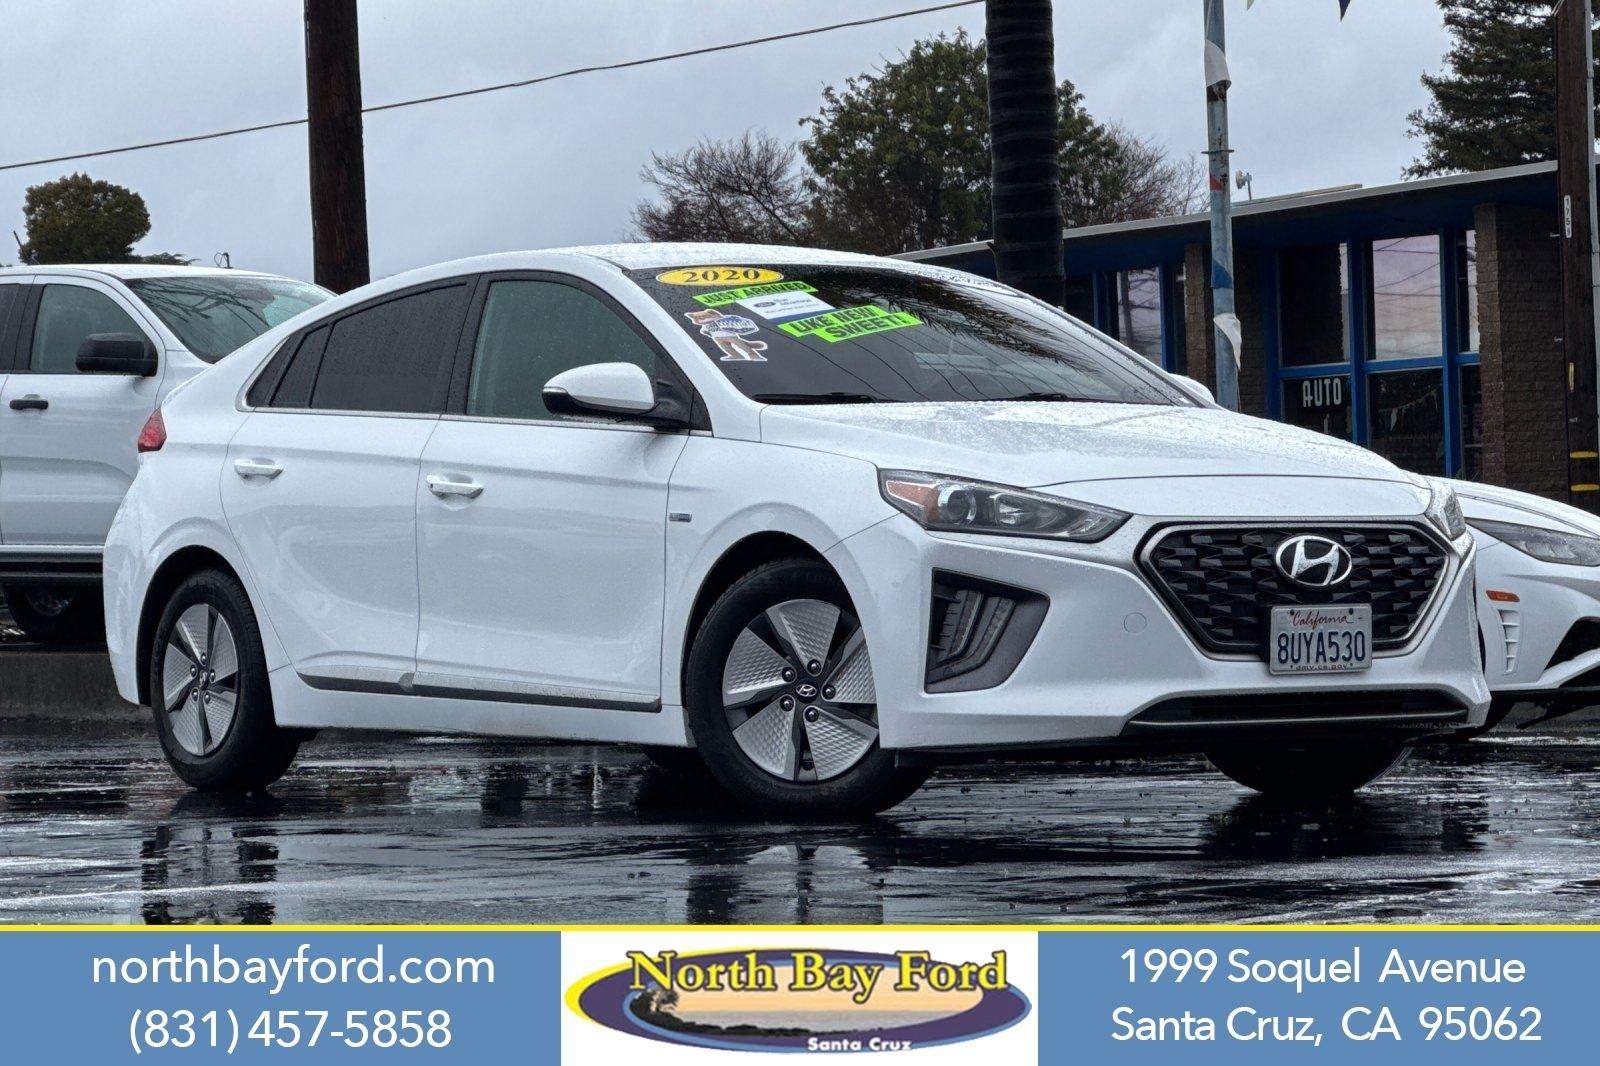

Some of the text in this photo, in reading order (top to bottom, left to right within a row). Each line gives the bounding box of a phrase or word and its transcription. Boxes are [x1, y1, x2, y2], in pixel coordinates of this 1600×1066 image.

[682, 269, 760, 283] 2020
[703, 289, 742, 304] JUST
[788, 315, 835, 333] LIKE
[830, 307, 878, 322] NEW
[1302, 378, 1342, 407] AUTO
[1292, 610, 1354, 629] California
[1277, 630, 1366, 664] 8UYA530
